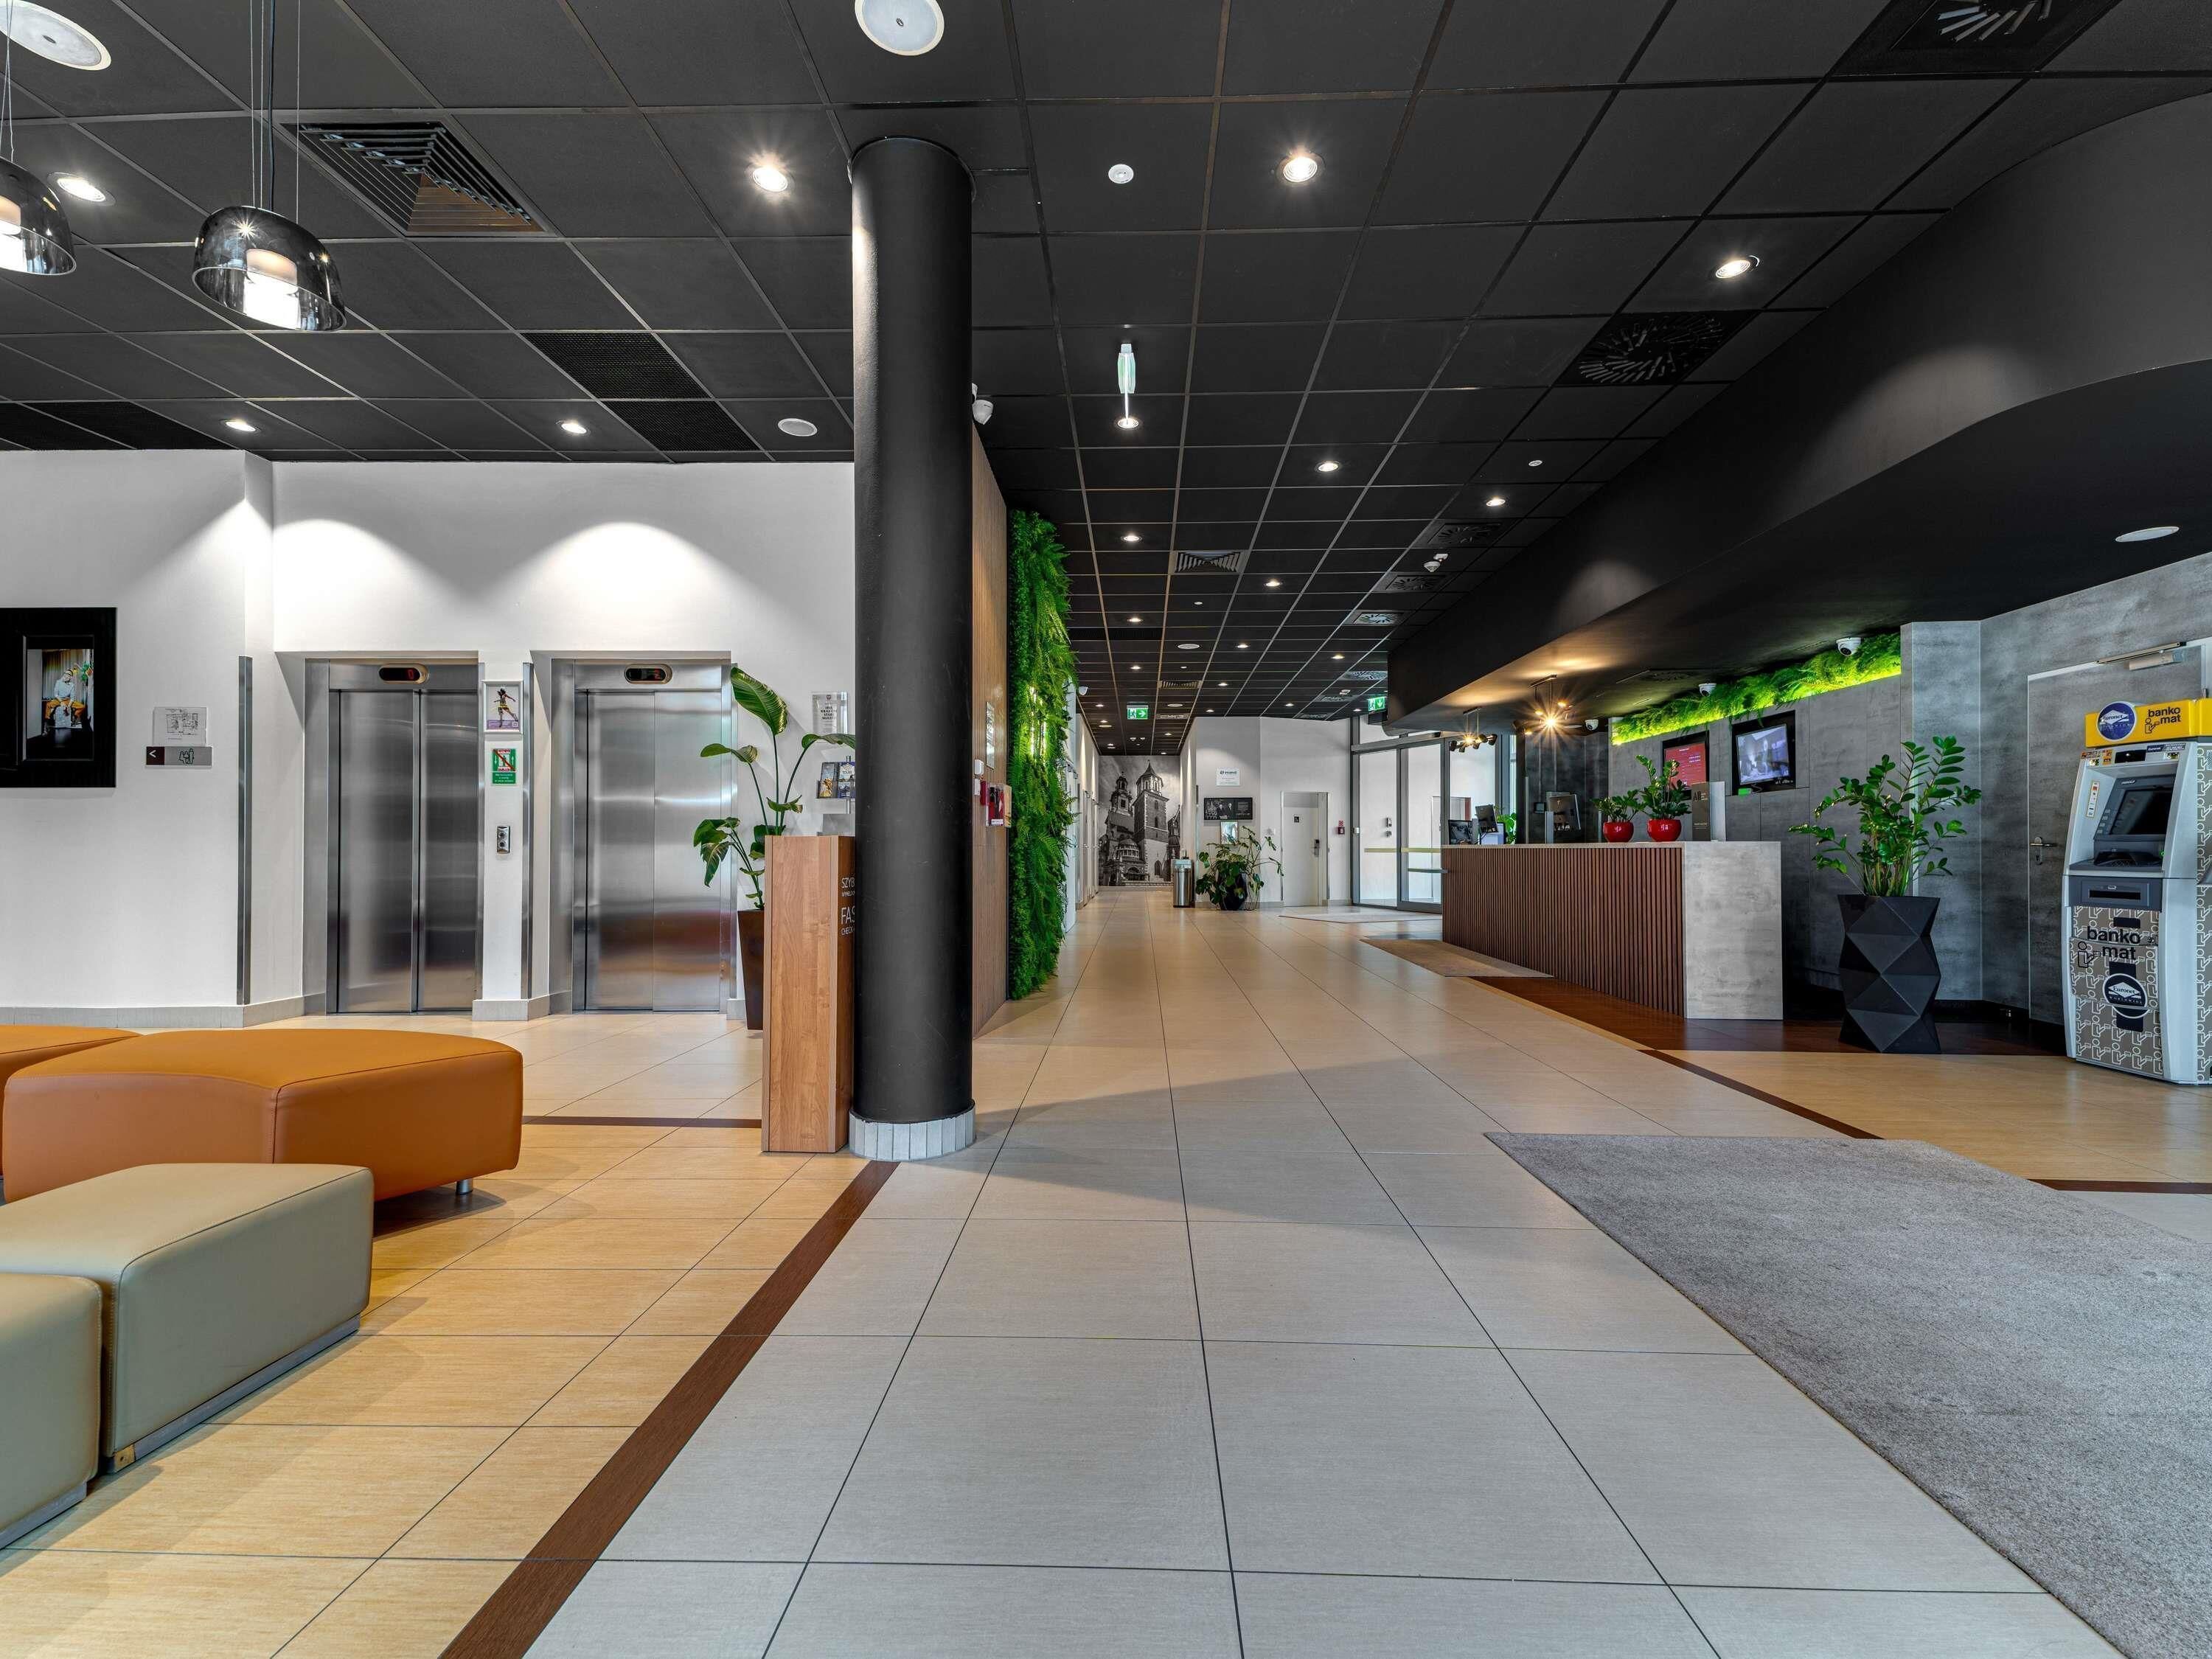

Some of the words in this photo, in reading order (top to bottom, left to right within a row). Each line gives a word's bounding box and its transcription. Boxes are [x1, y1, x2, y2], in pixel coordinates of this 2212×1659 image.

[2148, 706, 2181, 717] banko
[2160, 715, 2181, 724] mat
[2087, 926, 2140, 945] banko
[2102, 946, 2137, 960] mat
[2113, 986, 2135, 995] Euronet
